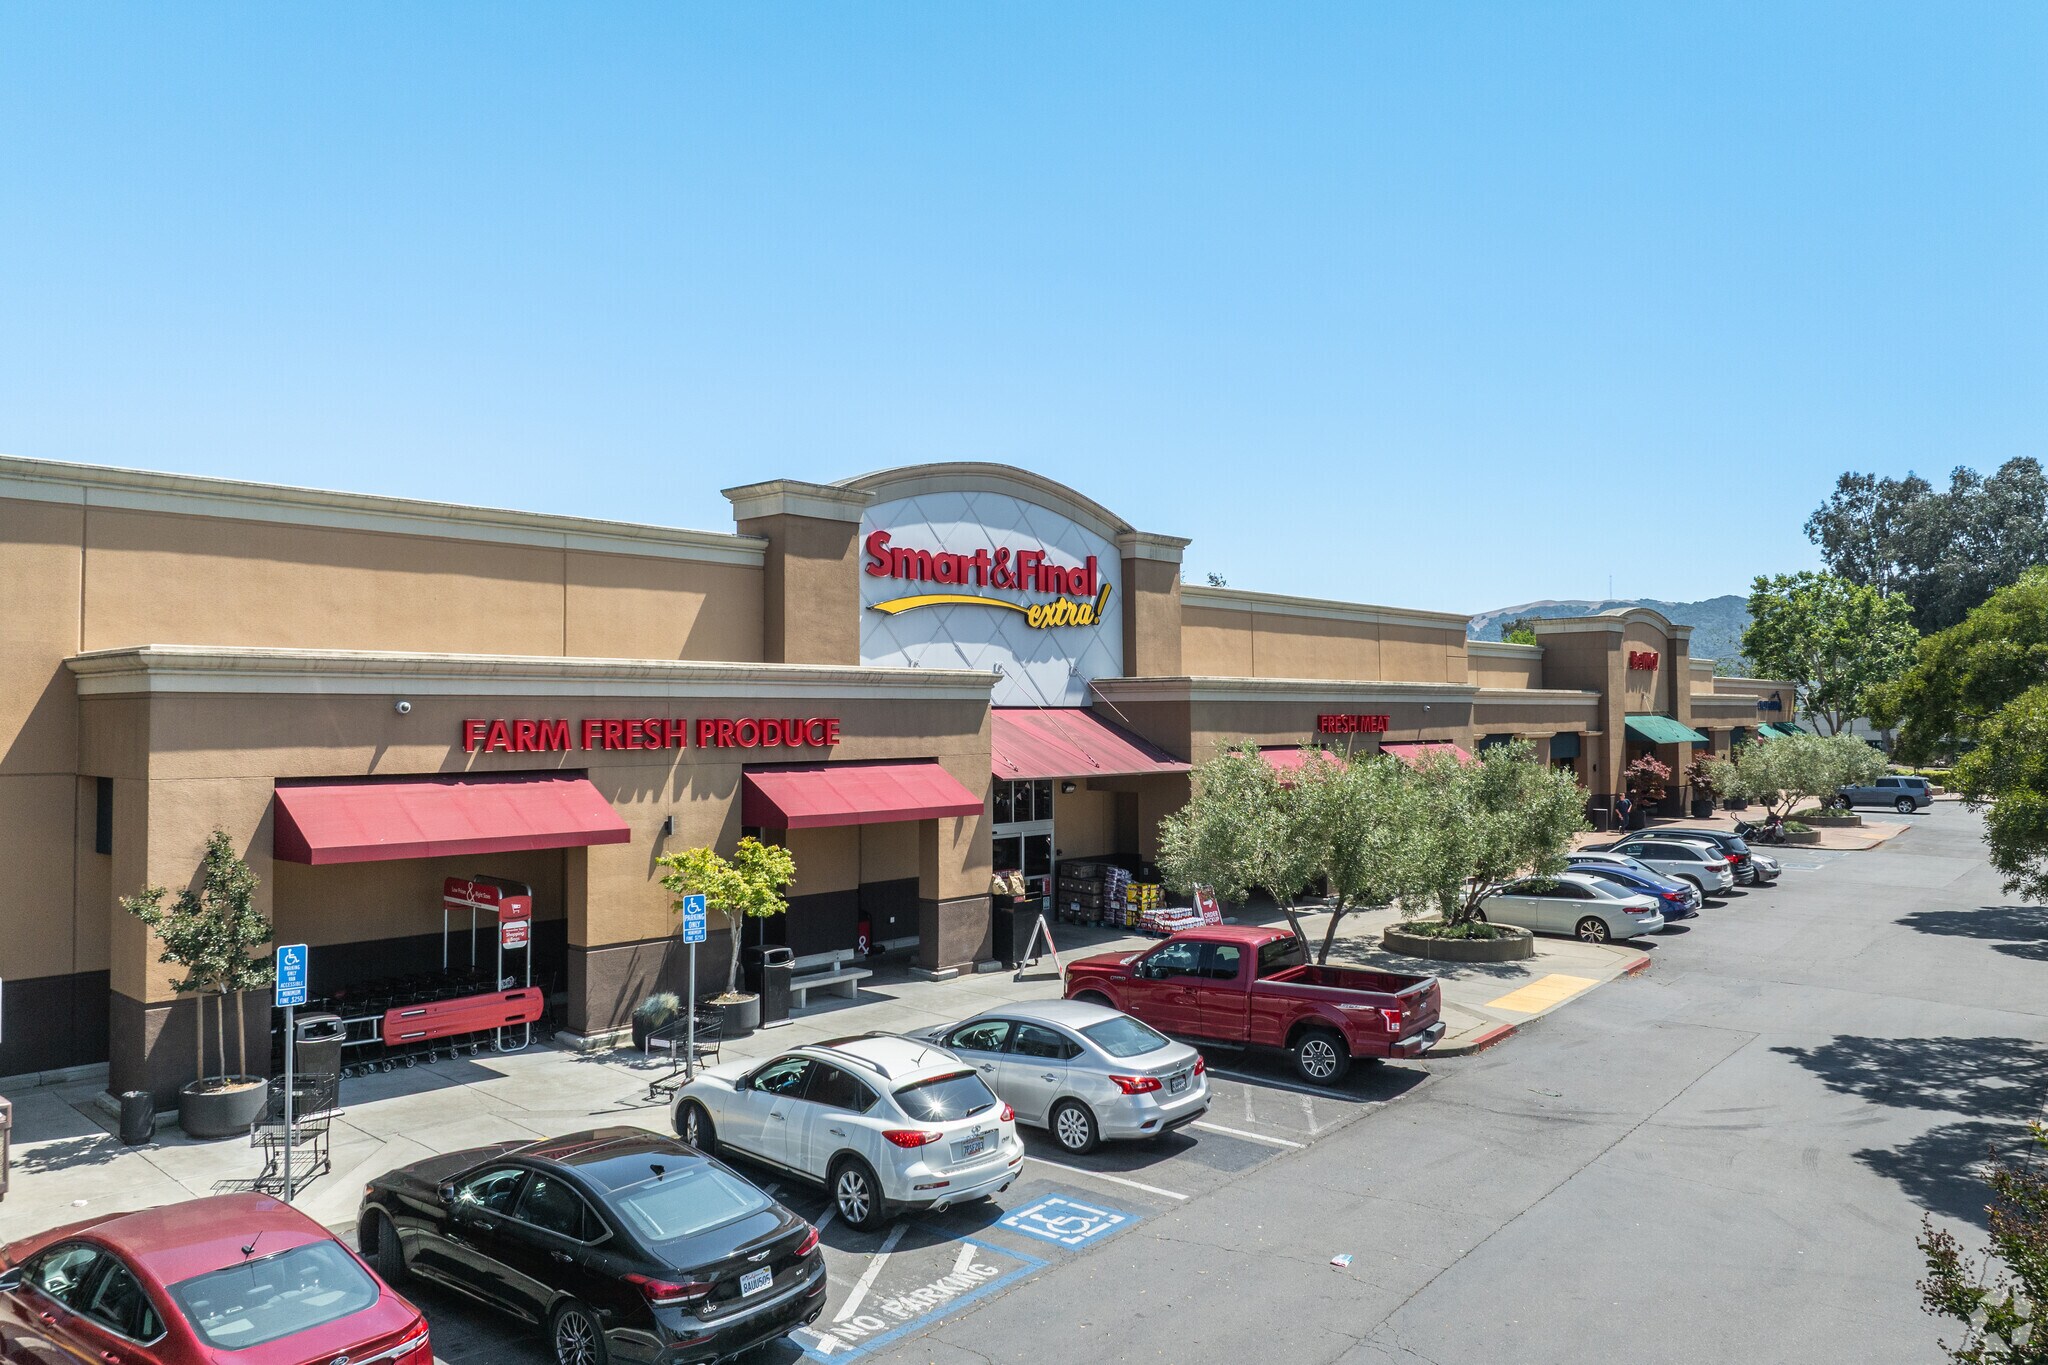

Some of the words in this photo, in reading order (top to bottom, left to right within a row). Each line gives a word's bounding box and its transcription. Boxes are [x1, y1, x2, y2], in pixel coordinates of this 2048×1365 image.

[865, 530, 1098, 597] Smart&Final
[1024, 582, 1112, 629] extra!
[1318, 714, 1359, 733] FRESH
[1360, 714, 1390, 732] MEAT
[463, 718, 572, 753] FARM
[581, 717, 687, 750] FRESH
[696, 717, 840, 748] PRODUCE
[685, 913, 705, 921] PARKING
[1204, 911, 1218, 919] ORDER
[689, 921, 701, 929] ONLY
[506, 931, 525, 939] Shopping
[830, 1315, 885, 1341] NO
[881, 1263, 998, 1319] PARKING
